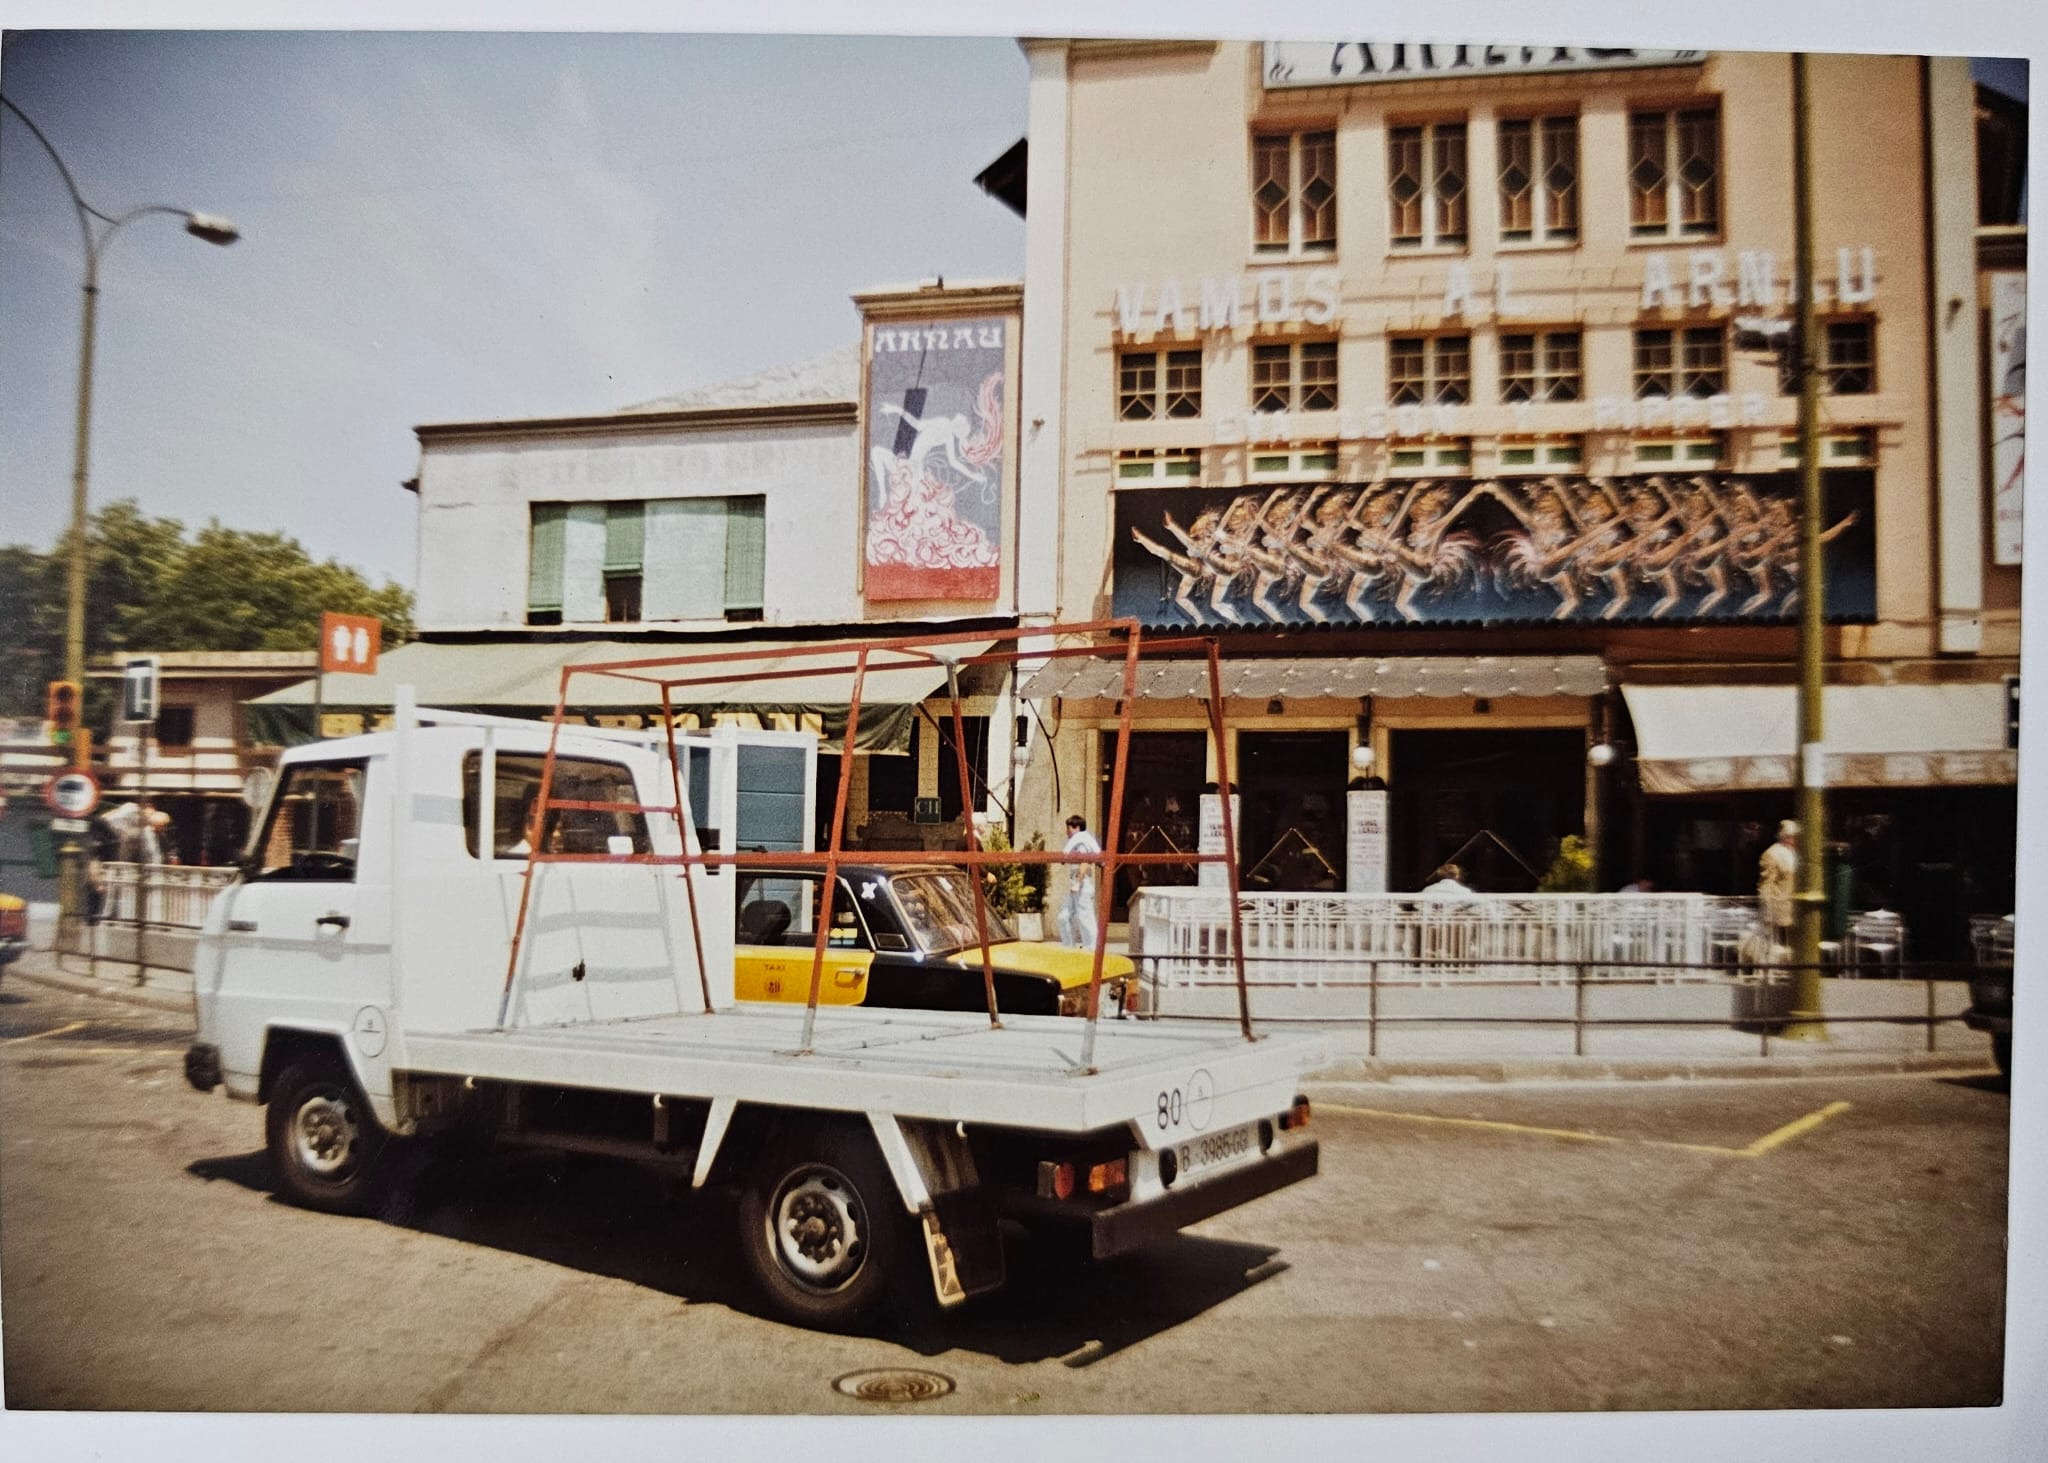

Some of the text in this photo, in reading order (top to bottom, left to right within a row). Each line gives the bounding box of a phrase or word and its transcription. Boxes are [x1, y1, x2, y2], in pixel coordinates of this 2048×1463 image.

[1117, 269, 1340, 334] VAMOS
[1443, 259, 1529, 317] AL
[875, 326, 1003, 352] ARNAU
[764, 962, 786, 972] TAXI
[1157, 1088, 1182, 1130] 80
